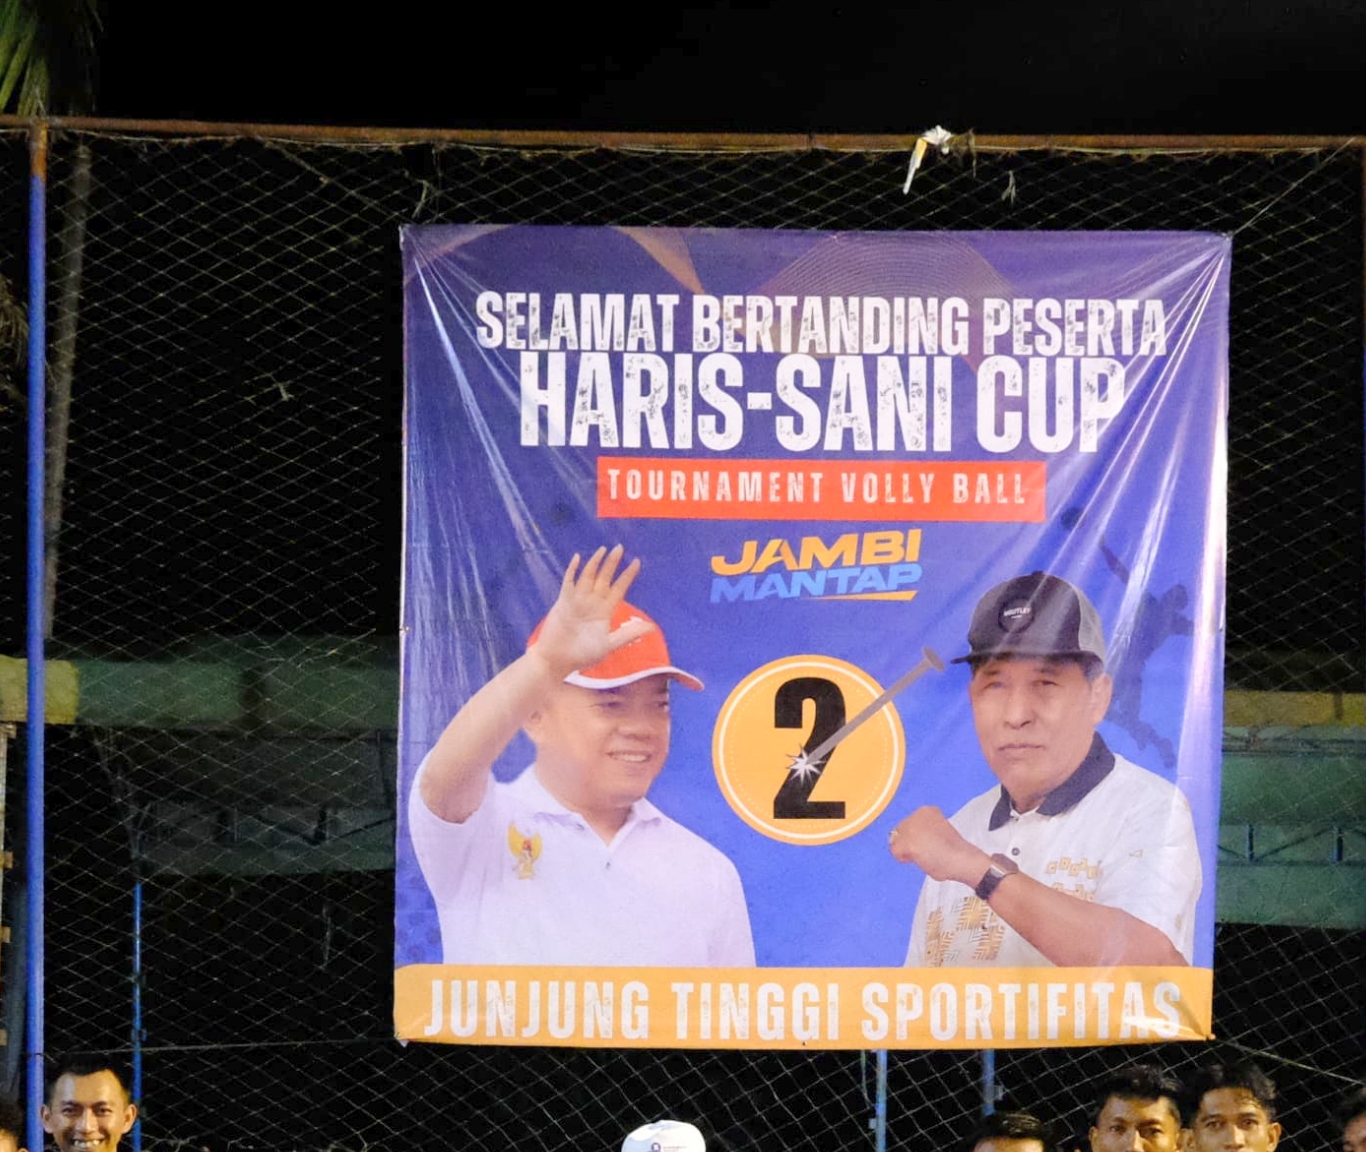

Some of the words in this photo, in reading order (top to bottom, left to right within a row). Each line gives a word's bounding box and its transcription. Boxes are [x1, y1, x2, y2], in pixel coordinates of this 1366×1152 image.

[476, 290, 678, 352] SELAMAT
[693, 294, 970, 357] BERTANDING
[983, 297, 1169, 357] PESERTA
[518, 351, 953, 453] HARIS-SANI
[976, 355, 1127, 454] CUP
[607, 468, 823, 505] TOURNAMENT
[841, 470, 936, 506] VOLLY
[952, 471, 1026, 506] BALL
[709, 562, 923, 603] MANTAP
[710, 528, 922, 576] JAMBI
[773, 675, 847, 821] 2
[423, 978, 650, 1041] JUNJUNG
[670, 980, 840, 1042] TINGGI
[861, 979, 1182, 1042] SPORTIFITAS
